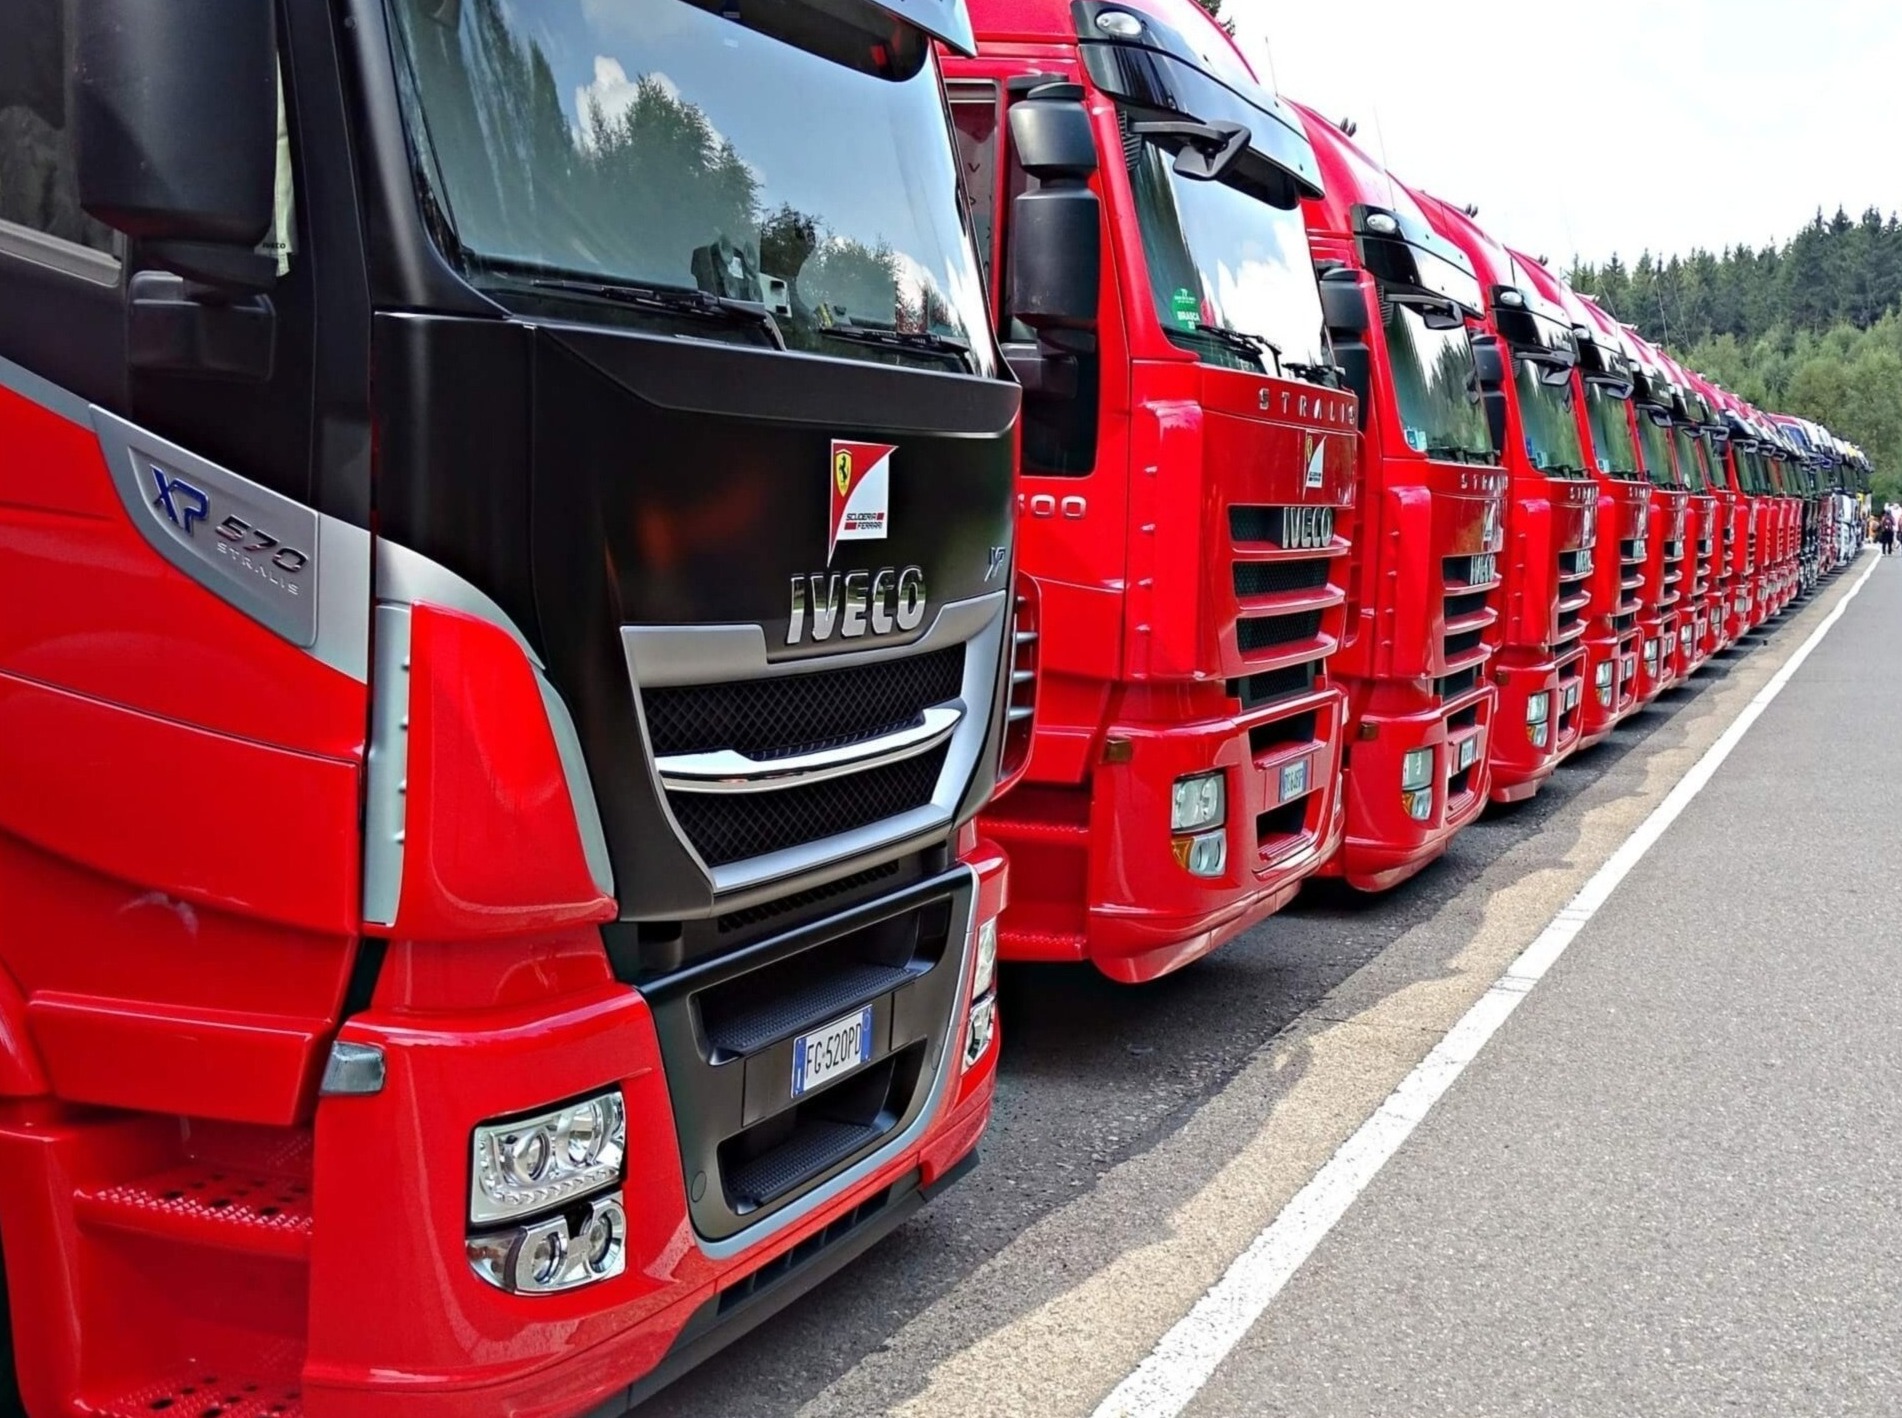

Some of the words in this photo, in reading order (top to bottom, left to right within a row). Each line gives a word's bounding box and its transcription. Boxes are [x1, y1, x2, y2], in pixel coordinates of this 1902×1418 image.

[1259, 387, 1355, 425] STRALIS
[150, 463, 209, 536] XP
[215, 513, 309, 573] 570
[1282, 506, 1333, 549] IVECO
[216, 541, 300, 596] STRALIS
[783, 564, 928, 645] IVECO
